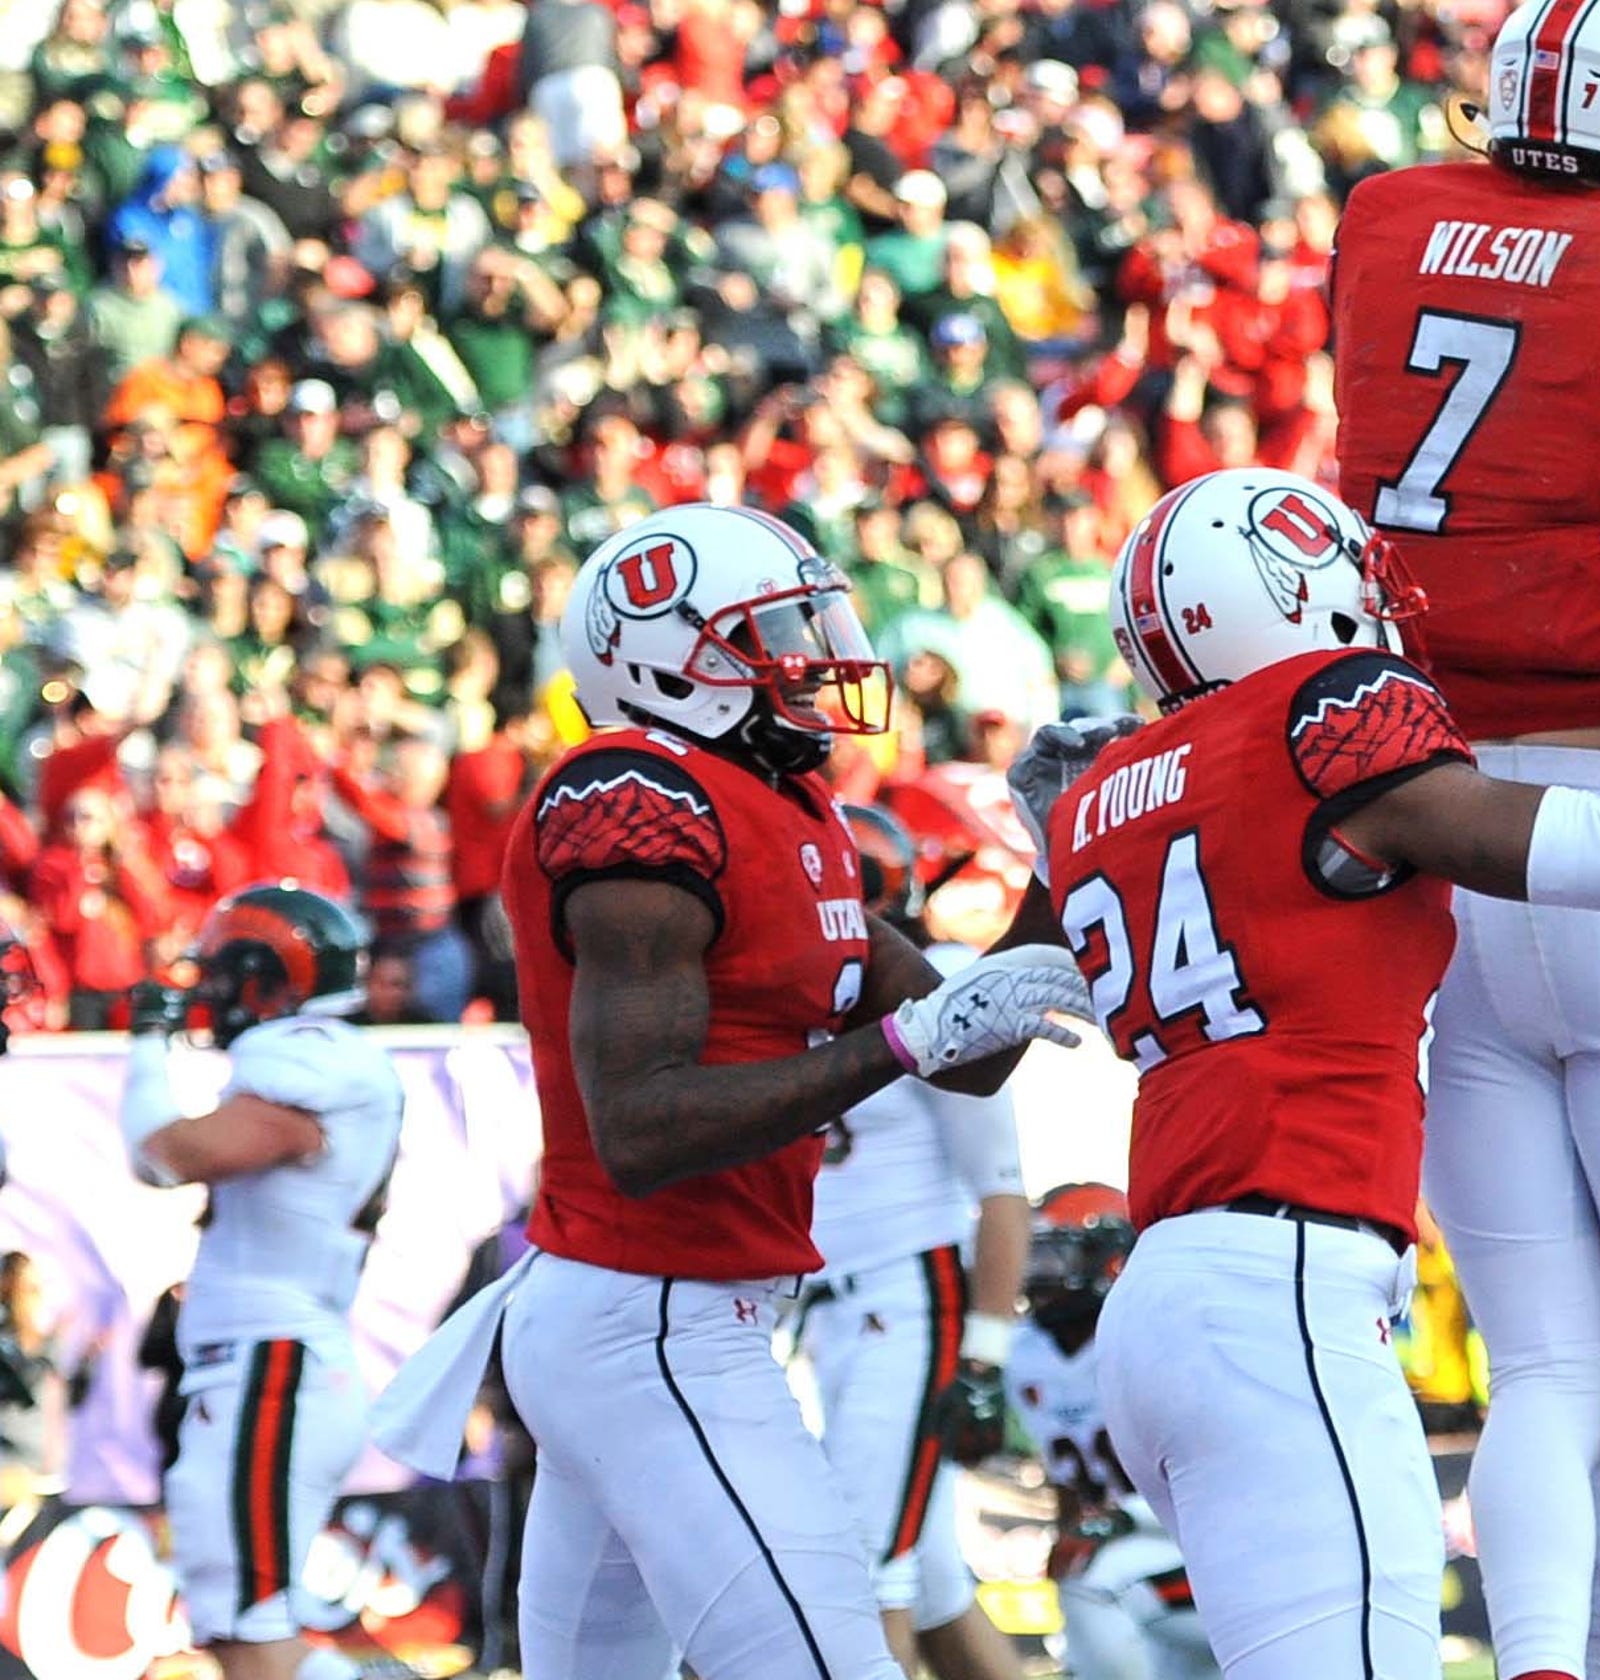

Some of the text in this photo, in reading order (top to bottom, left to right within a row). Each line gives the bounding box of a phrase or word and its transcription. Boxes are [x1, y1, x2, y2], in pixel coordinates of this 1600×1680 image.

[1581, 83, 1598, 109] 7
[1512, 148, 1579, 173] UTES
[1418, 220, 1574, 287] WILSON
[1370, 306, 1522, 534] 7
[1259, 493, 1333, 558] U
[617, 541, 677, 609] U
[1181, 602, 1213, 634] 24
[816, 898, 868, 941] UTA
[1060, 828, 1266, 1078] 24
